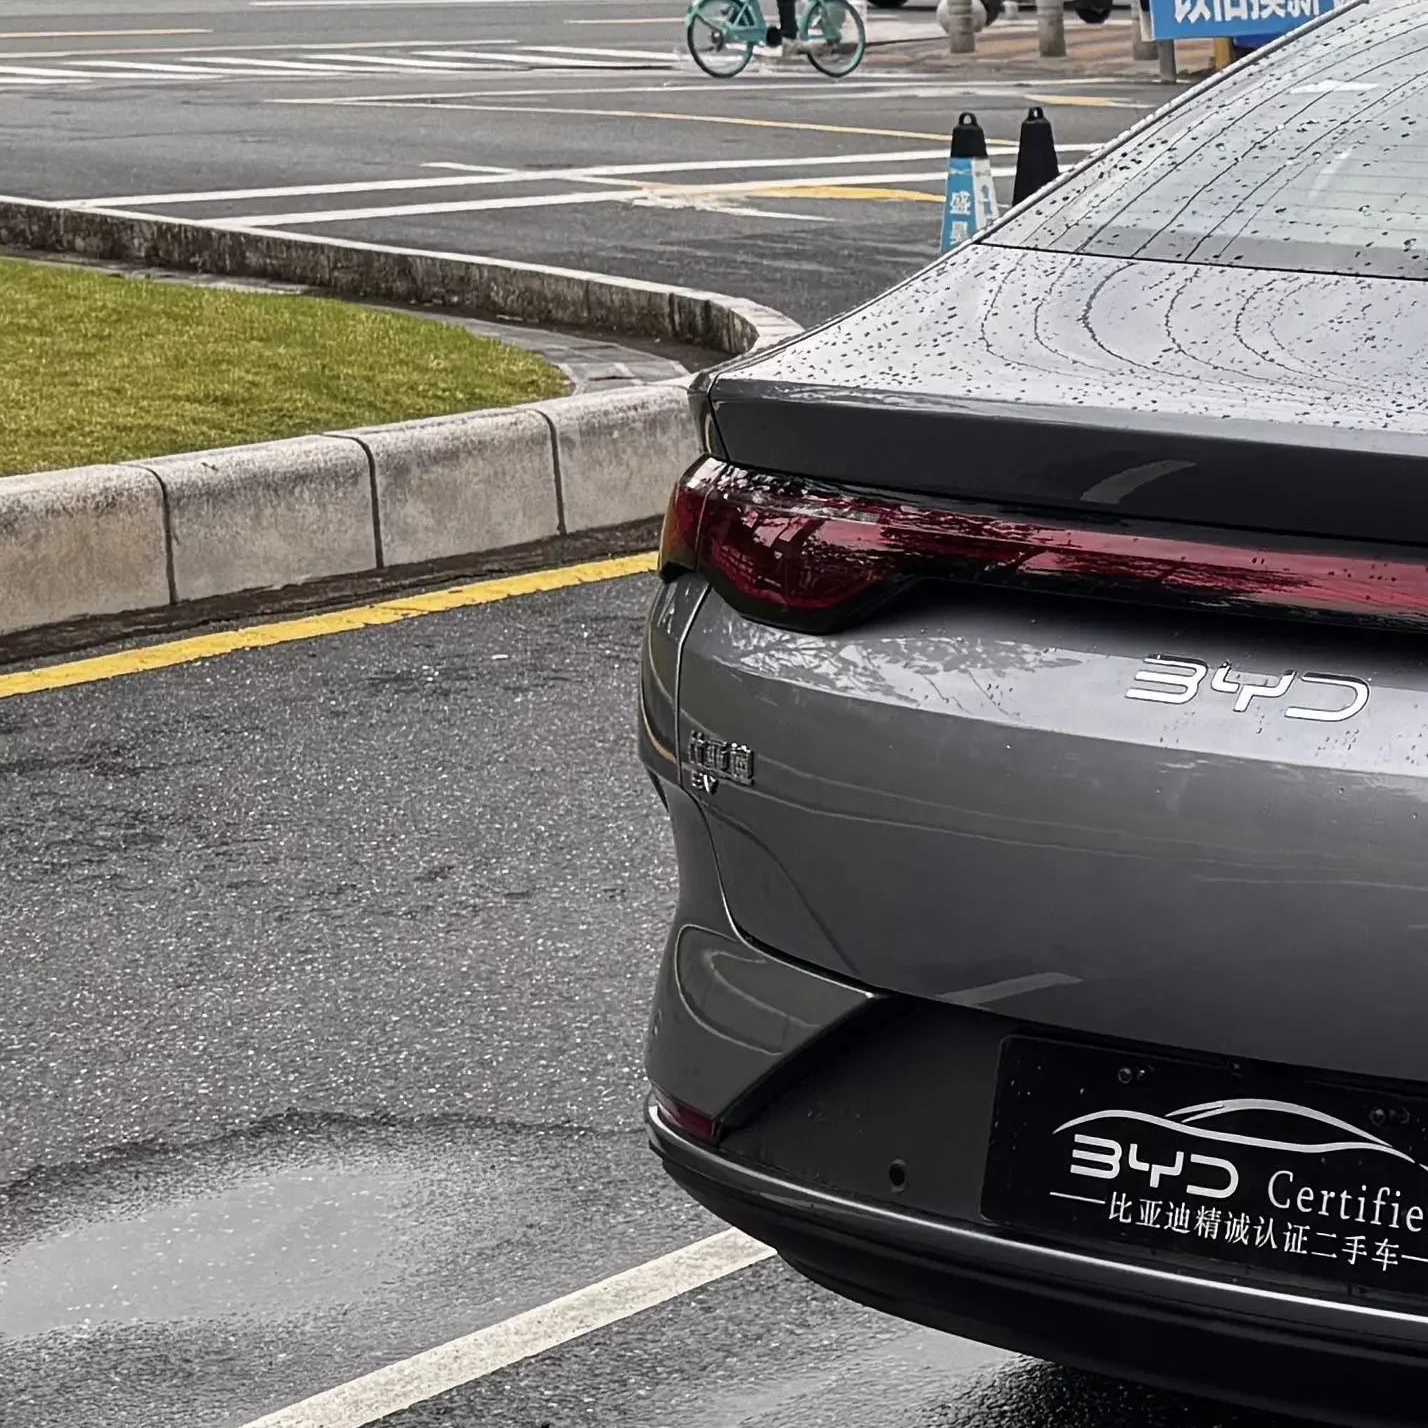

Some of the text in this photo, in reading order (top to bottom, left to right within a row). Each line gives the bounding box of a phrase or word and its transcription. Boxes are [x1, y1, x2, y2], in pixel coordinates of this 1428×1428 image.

[1125, 653, 1370, 723] BYD
[1070, 1134, 1239, 1199] BYD
[1107, 1191, 1401, 1271] 比亚迪精诚认证二手车
